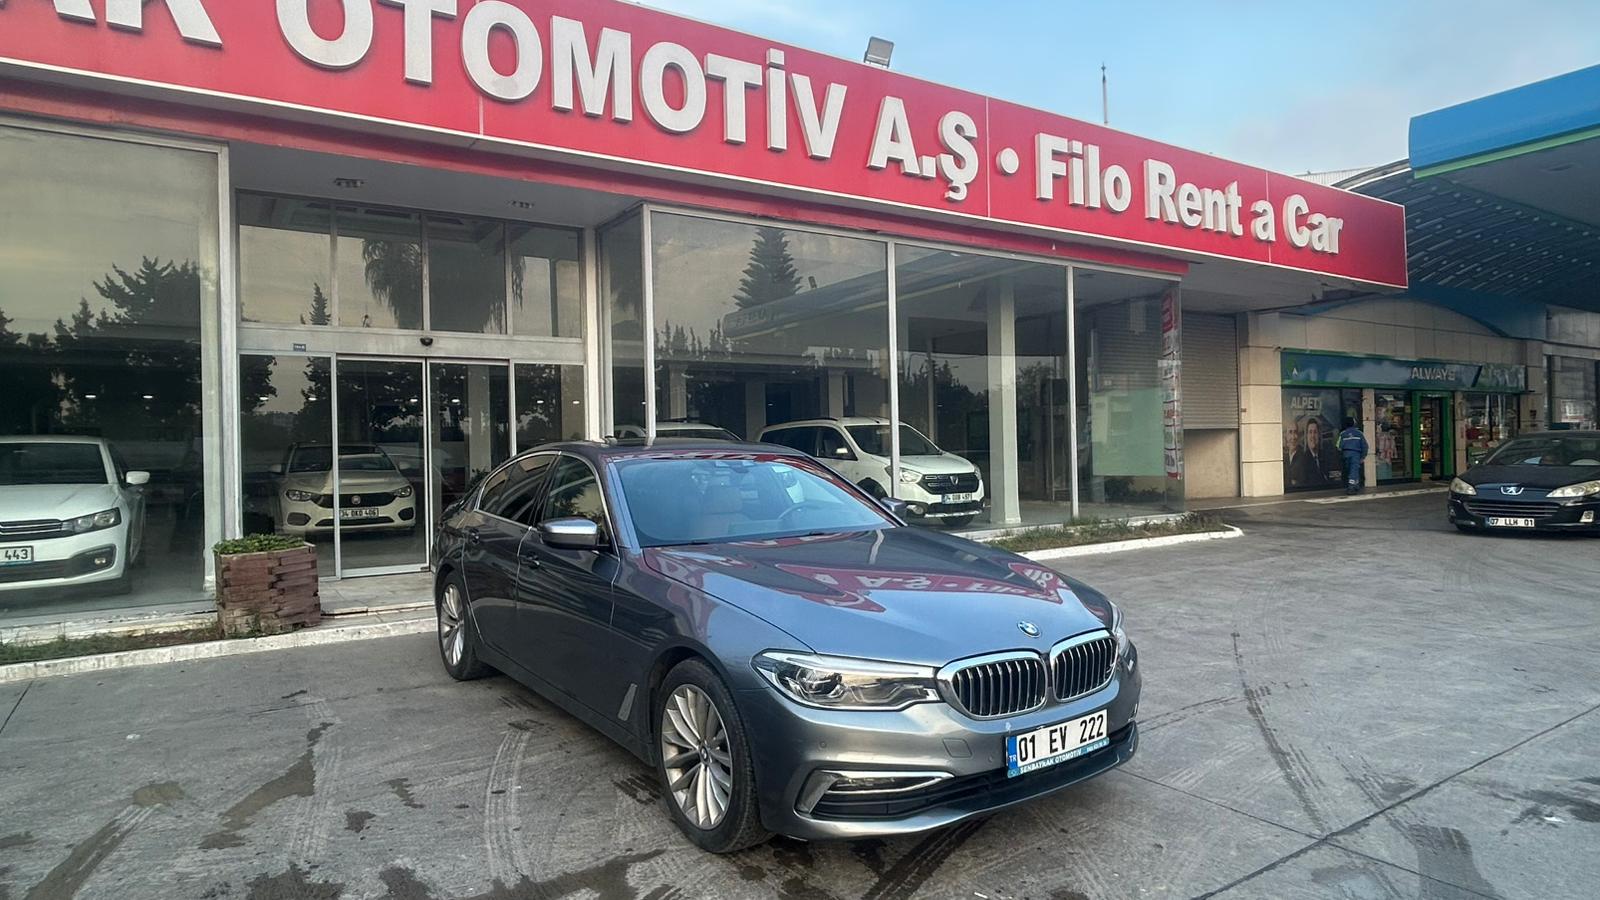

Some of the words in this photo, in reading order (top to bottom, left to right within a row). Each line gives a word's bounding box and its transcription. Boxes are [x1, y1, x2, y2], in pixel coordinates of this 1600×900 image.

[276, 0, 848, 159] OTOMOTİV
[867, 95, 979, 201] A.Ş
[1035, 132, 1132, 213] Filo
[1144, 159, 1243, 237] Rent
[1250, 200, 1276, 242] a
[1283, 194, 1343, 254] Car
[1524, 519, 1533, 527] 01
[4, 548, 29, 560] 443
[1018, 735, 1035, 762] 01
[1049, 725, 1067, 754] EV
[1080, 714, 1104, 743] 222
[1009, 754, 1017, 763] TR
